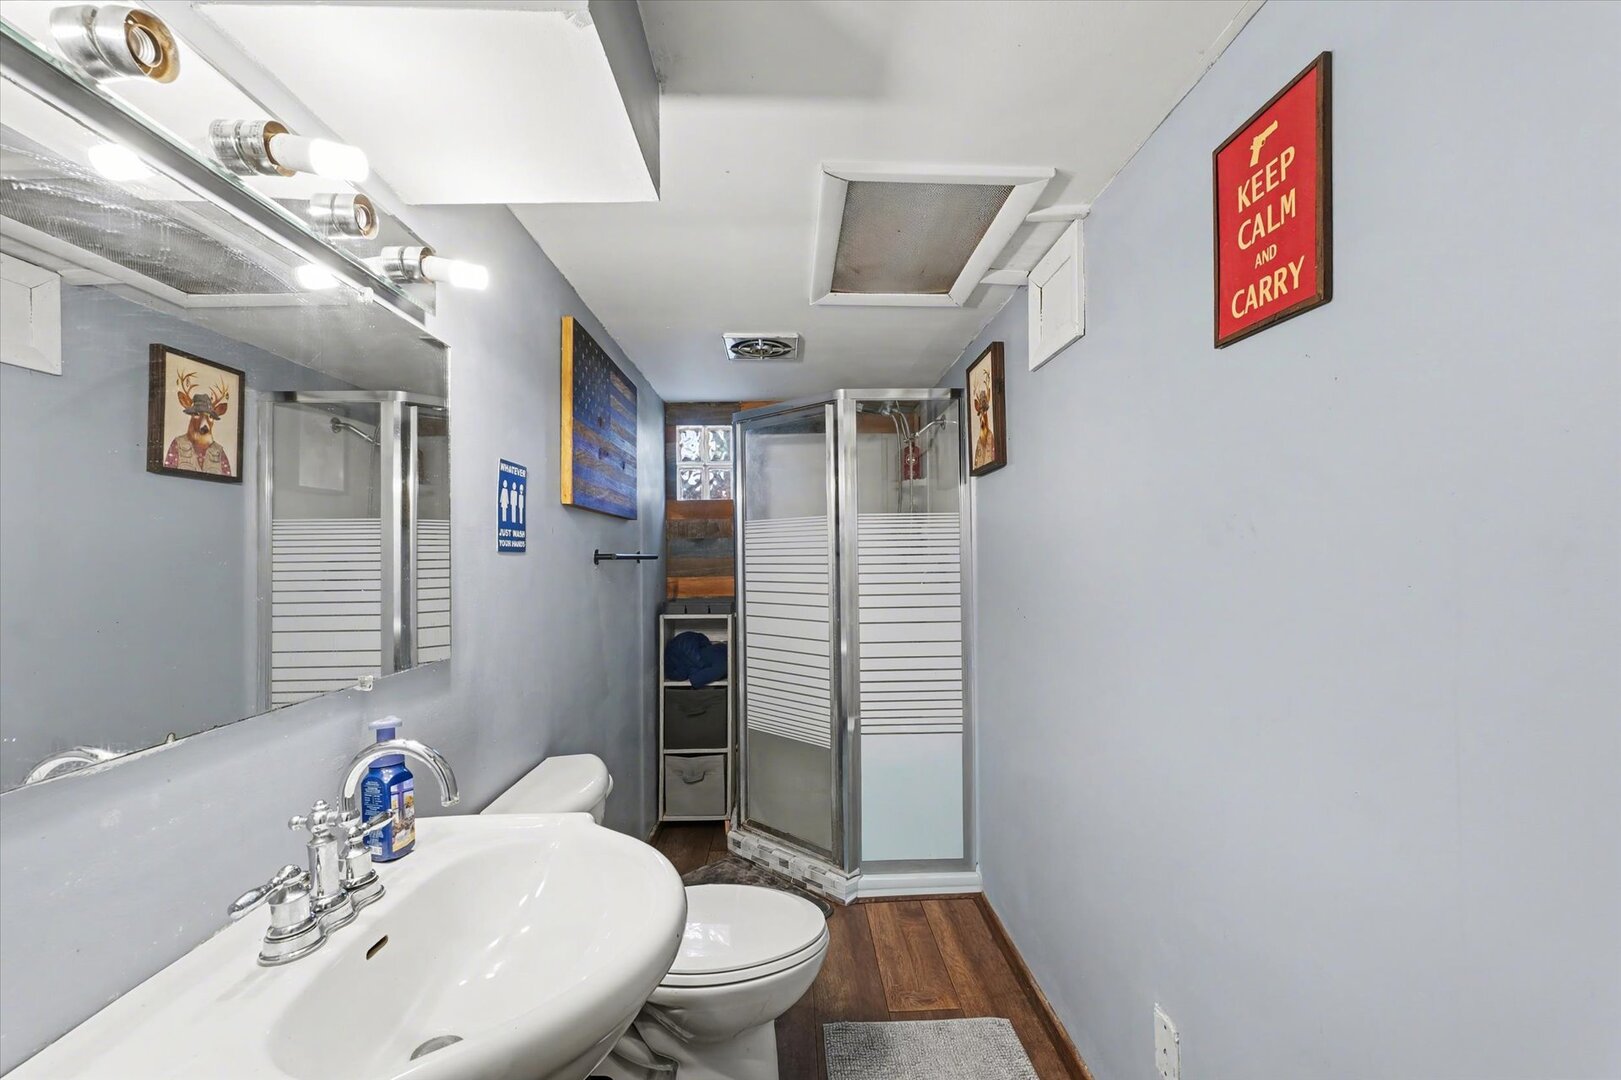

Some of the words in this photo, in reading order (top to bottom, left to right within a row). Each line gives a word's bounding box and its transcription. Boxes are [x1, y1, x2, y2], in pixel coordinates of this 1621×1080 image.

[1237, 145, 1296, 213] KEEP
[1237, 188, 1296, 251] CALM
[1254, 243, 1278, 269] AND
[1231, 255, 1305, 319] CARRY
[500, 462, 527, 478] WHATEVER
[499, 528, 511, 537] JUST
[512, 529, 526, 538] WASH
[499, 539, 511, 547] YOUR
[511, 540, 526, 548] HANDS
